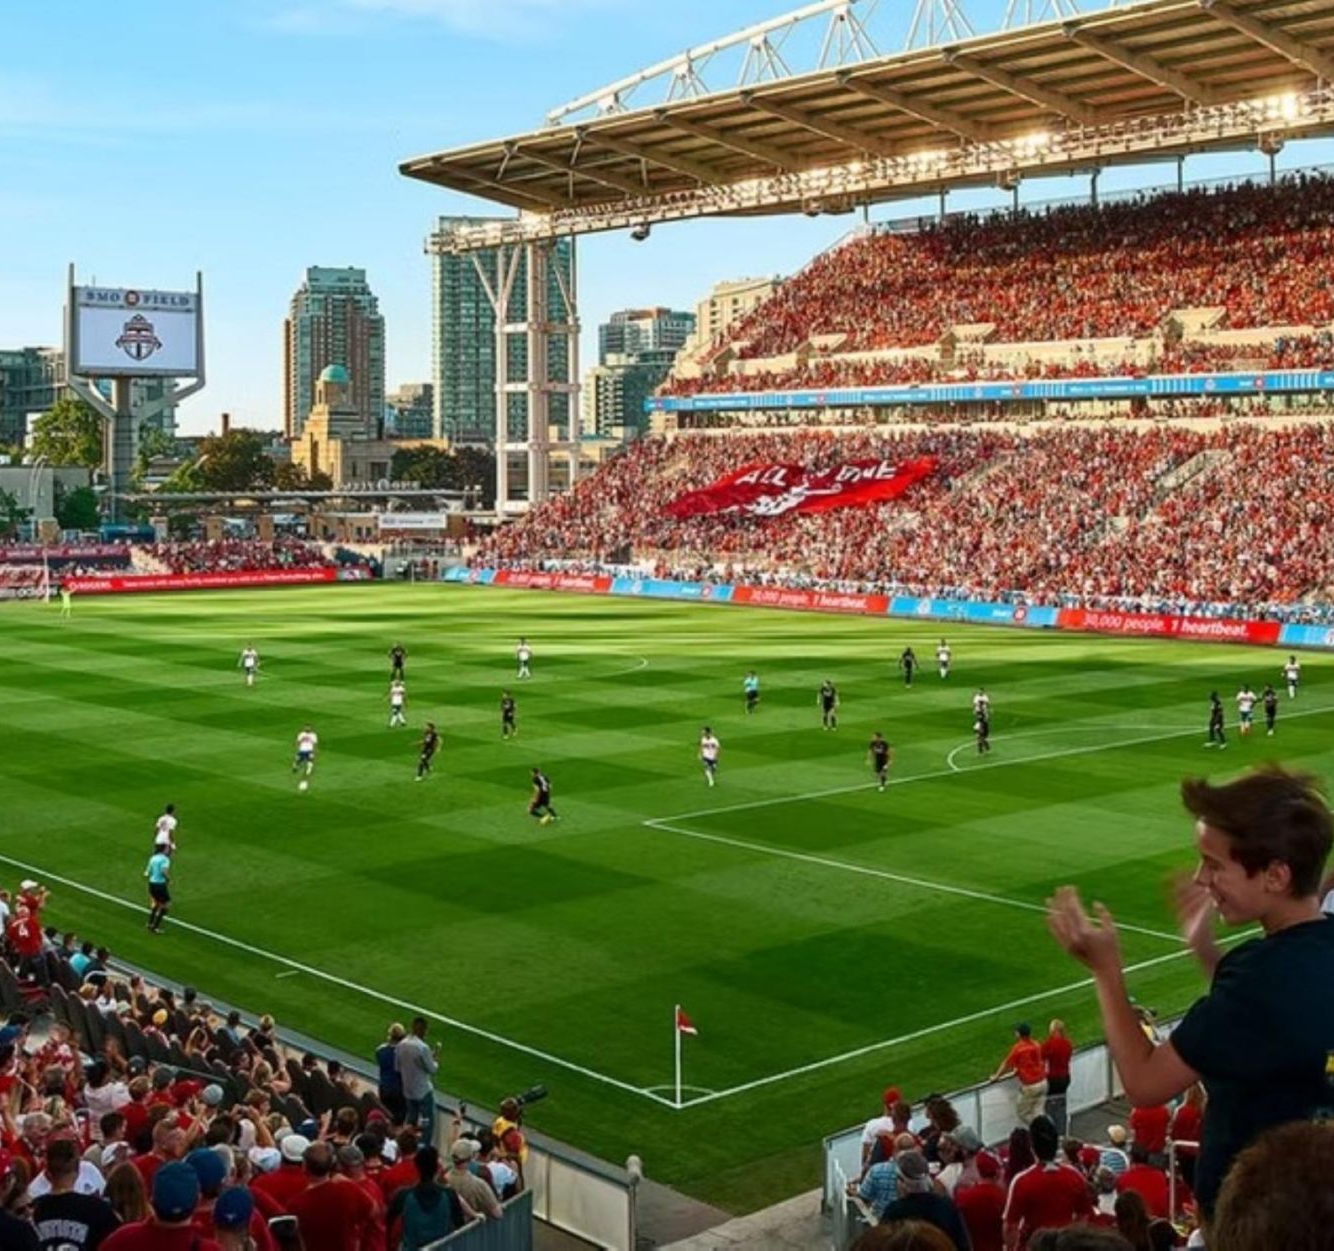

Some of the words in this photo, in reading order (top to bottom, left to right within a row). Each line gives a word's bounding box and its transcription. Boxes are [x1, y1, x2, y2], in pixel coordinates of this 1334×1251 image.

[86, 291, 121, 302] BMO
[143, 294, 190, 306] FIELD
[735, 466, 788, 487] ALL
